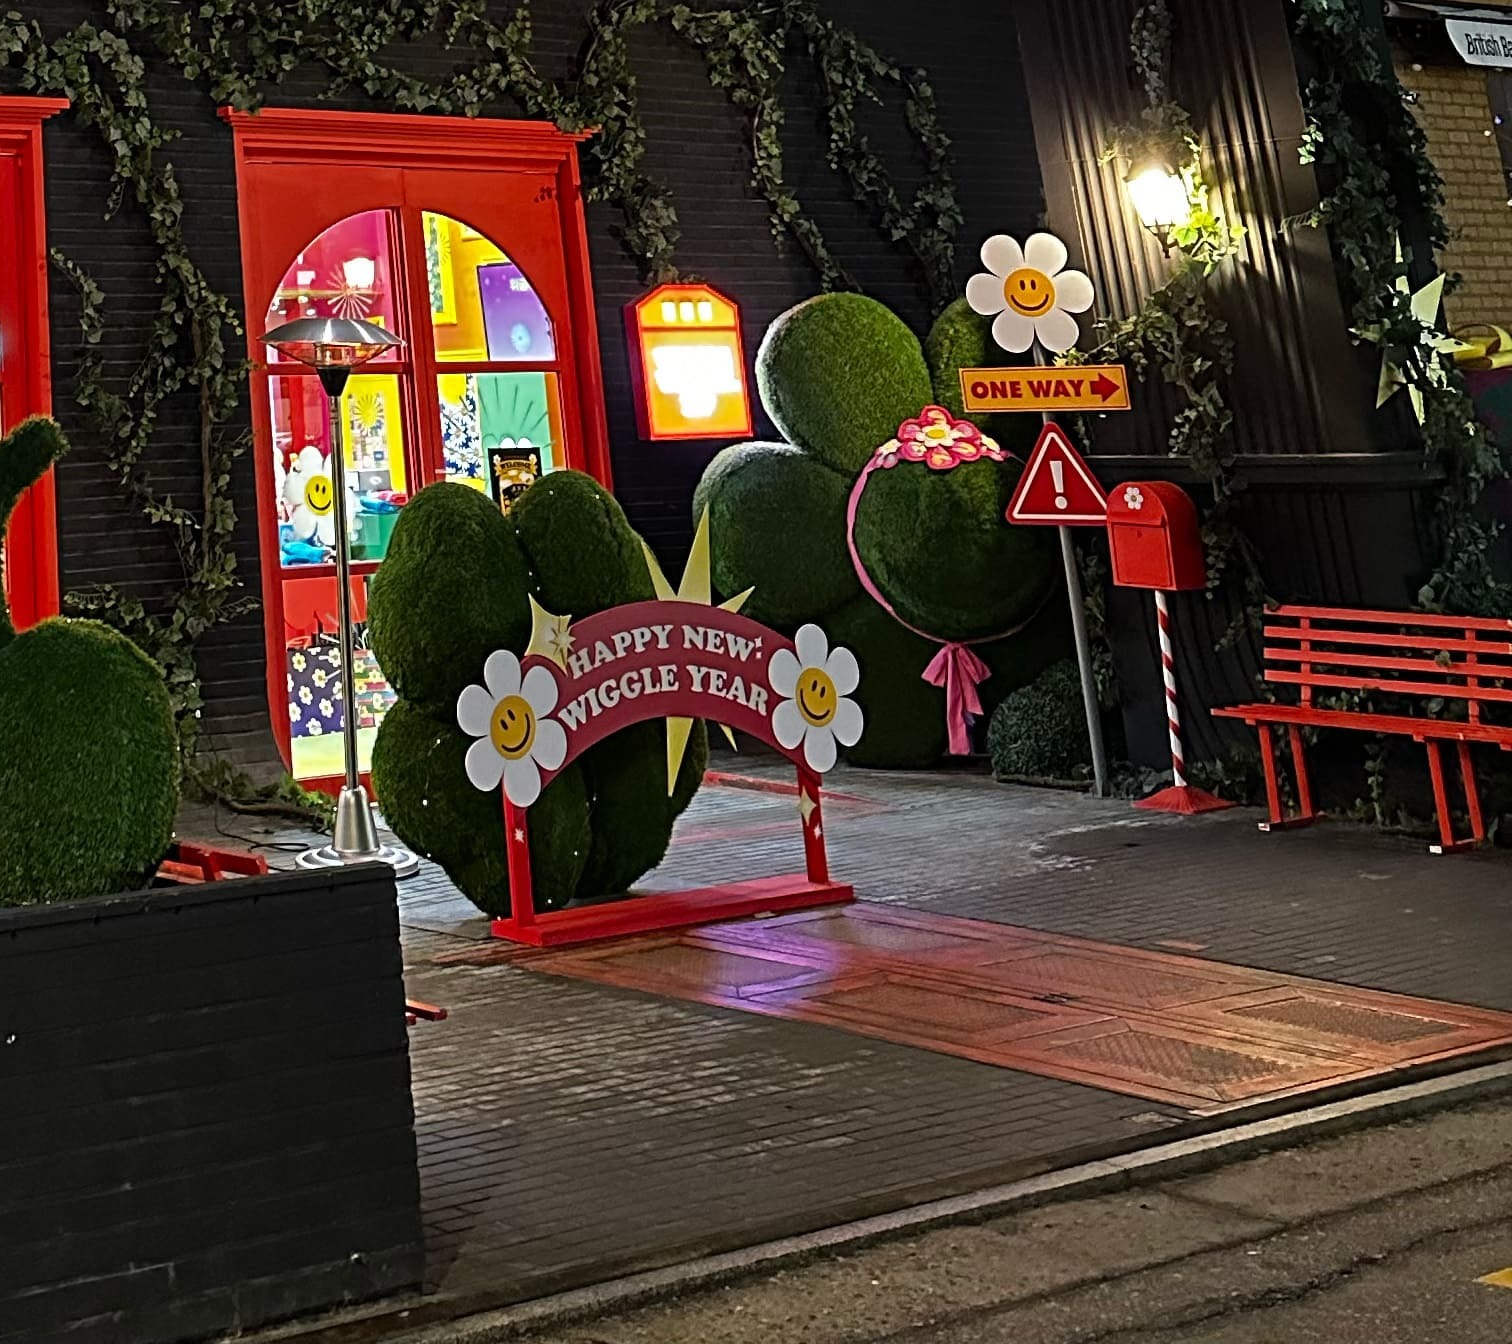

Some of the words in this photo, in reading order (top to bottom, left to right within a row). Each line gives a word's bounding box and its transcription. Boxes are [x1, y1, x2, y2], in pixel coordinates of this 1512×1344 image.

[1465, 33, 1502, 57] British
[971, 381, 1023, 400] ONE
[1026, 379, 1084, 399] WAY
[567, 625, 674, 679] HAPPY
[681, 625, 755, 662] NEW
[558, 664, 679, 731] WIGGLE
[686, 664, 769, 716] YEAR
